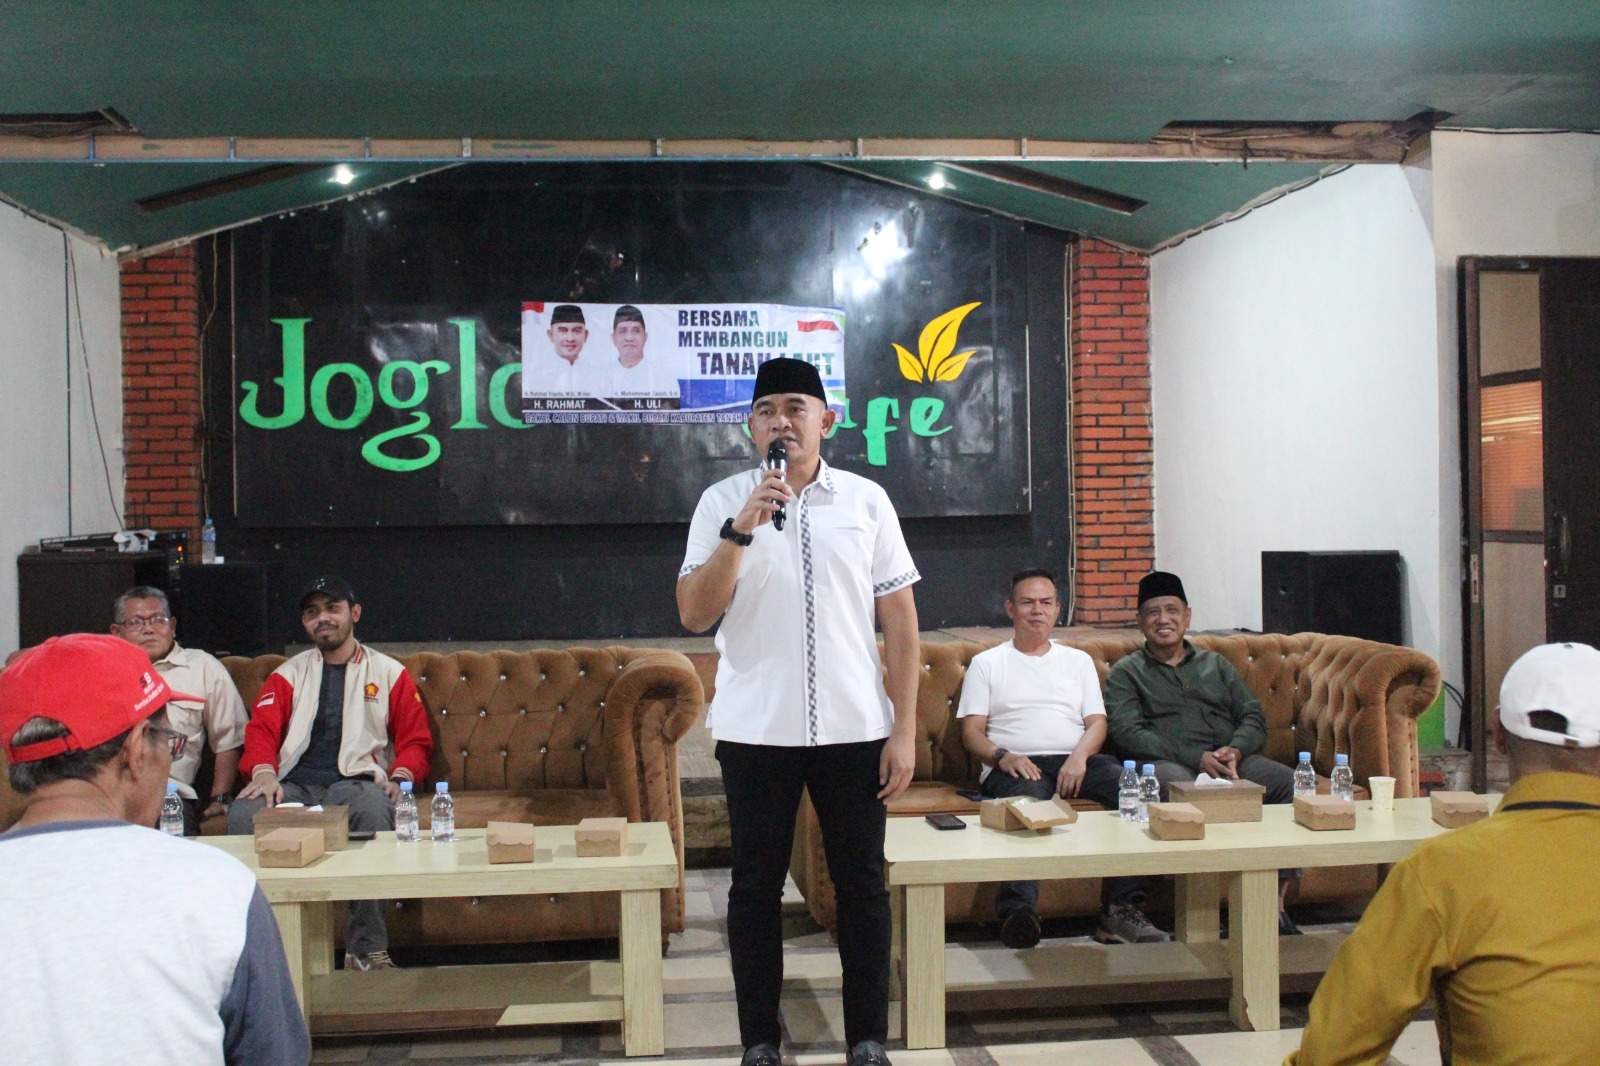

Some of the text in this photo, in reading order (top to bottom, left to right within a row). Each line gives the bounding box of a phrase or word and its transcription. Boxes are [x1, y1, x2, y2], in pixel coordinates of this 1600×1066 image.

[678, 310, 759, 327] BERSAMA
[678, 331, 788, 347] MEMBANGUN
[534, 400, 586, 409] H. RAHMAT
[634, 400, 661, 409] H. ULI
